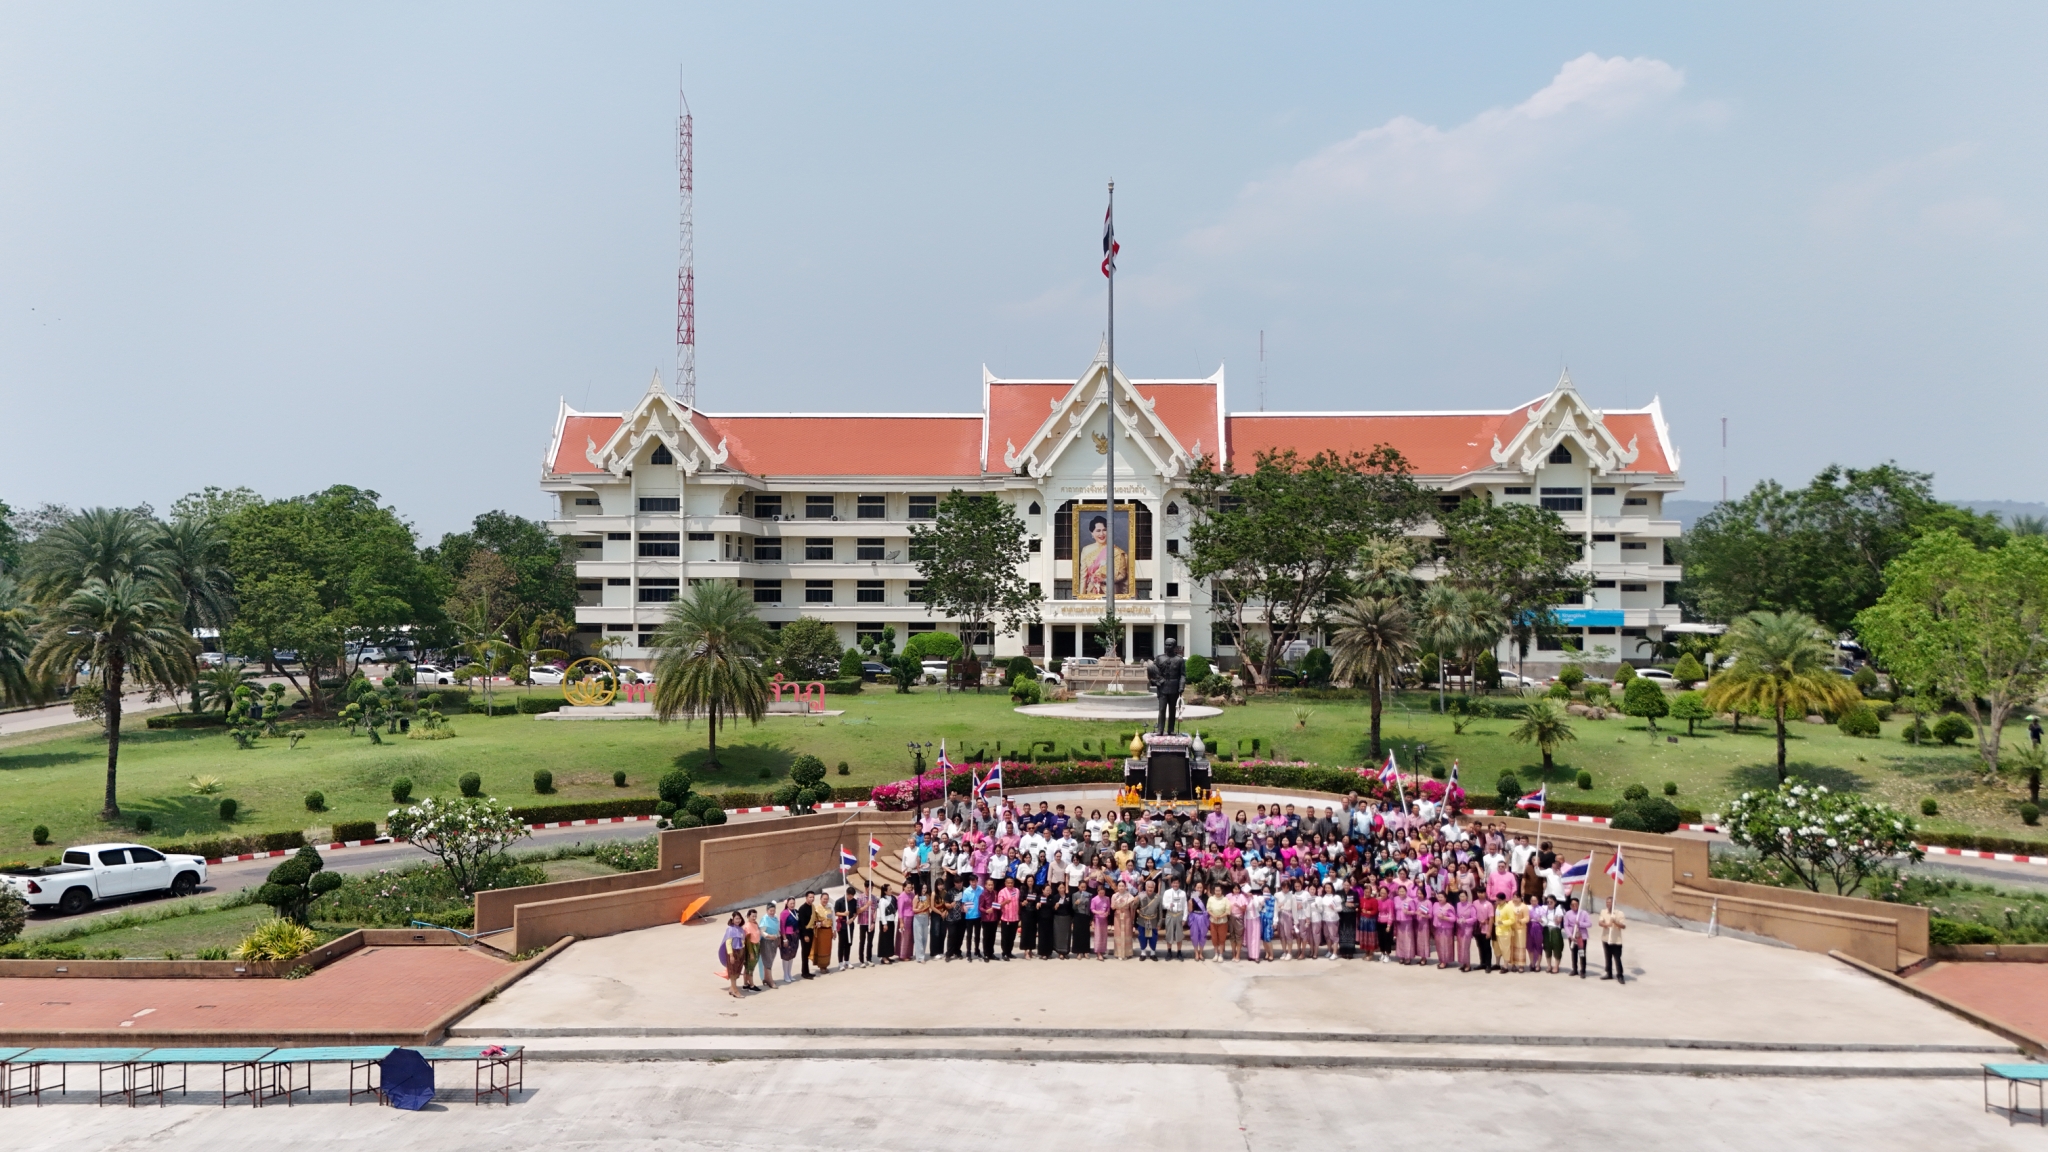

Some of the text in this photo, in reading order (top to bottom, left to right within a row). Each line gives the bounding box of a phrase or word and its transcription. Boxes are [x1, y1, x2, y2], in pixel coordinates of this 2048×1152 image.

[1061, 485, 1147, 496] ศาลากลางจังหวันองบัวลำภู
